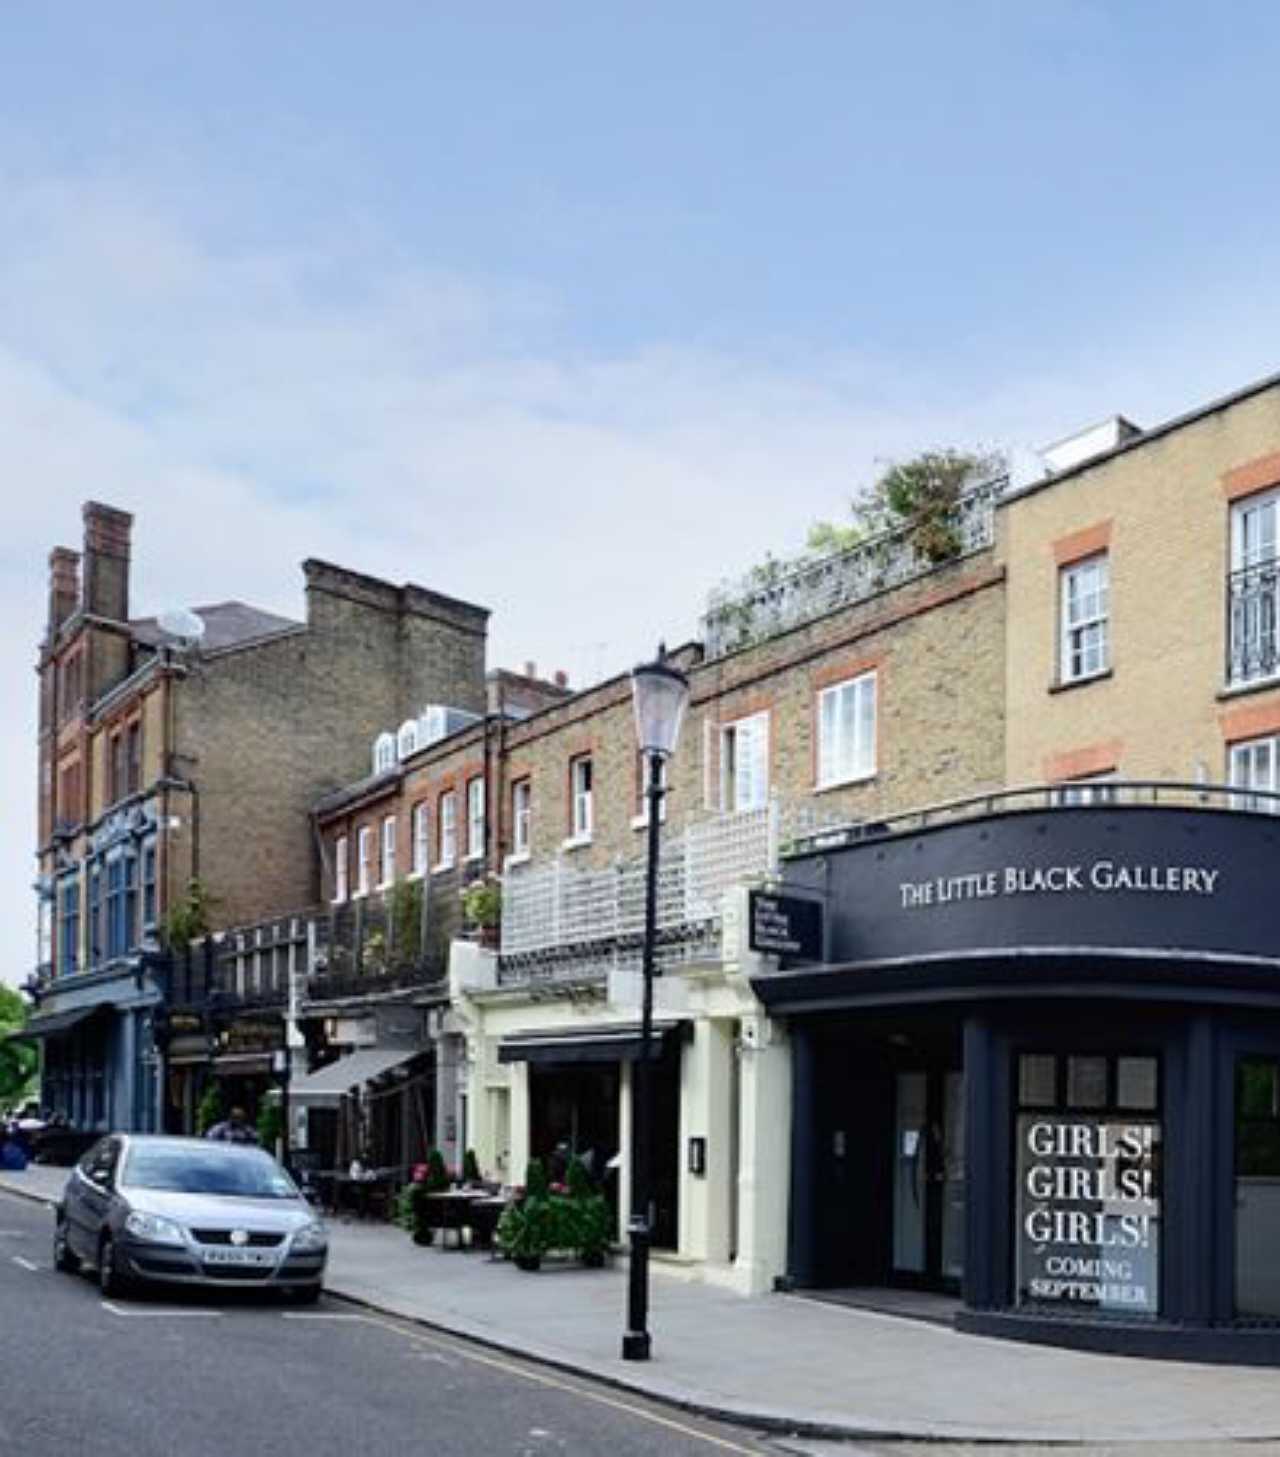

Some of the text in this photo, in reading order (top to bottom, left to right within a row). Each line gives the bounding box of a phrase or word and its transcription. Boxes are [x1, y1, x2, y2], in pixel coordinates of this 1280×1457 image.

[900, 860, 1219, 908] THE LITTLE BLACK GALLERY
[1027, 1122, 1152, 1159] GIRLS!
[1026, 1165, 1152, 1205] GIRLS!
[1025, 1207, 1150, 1248] GIRLS!
[1046, 1256, 1133, 1279] COMING
[1030, 1278, 1147, 1304] SEPTEMBER
